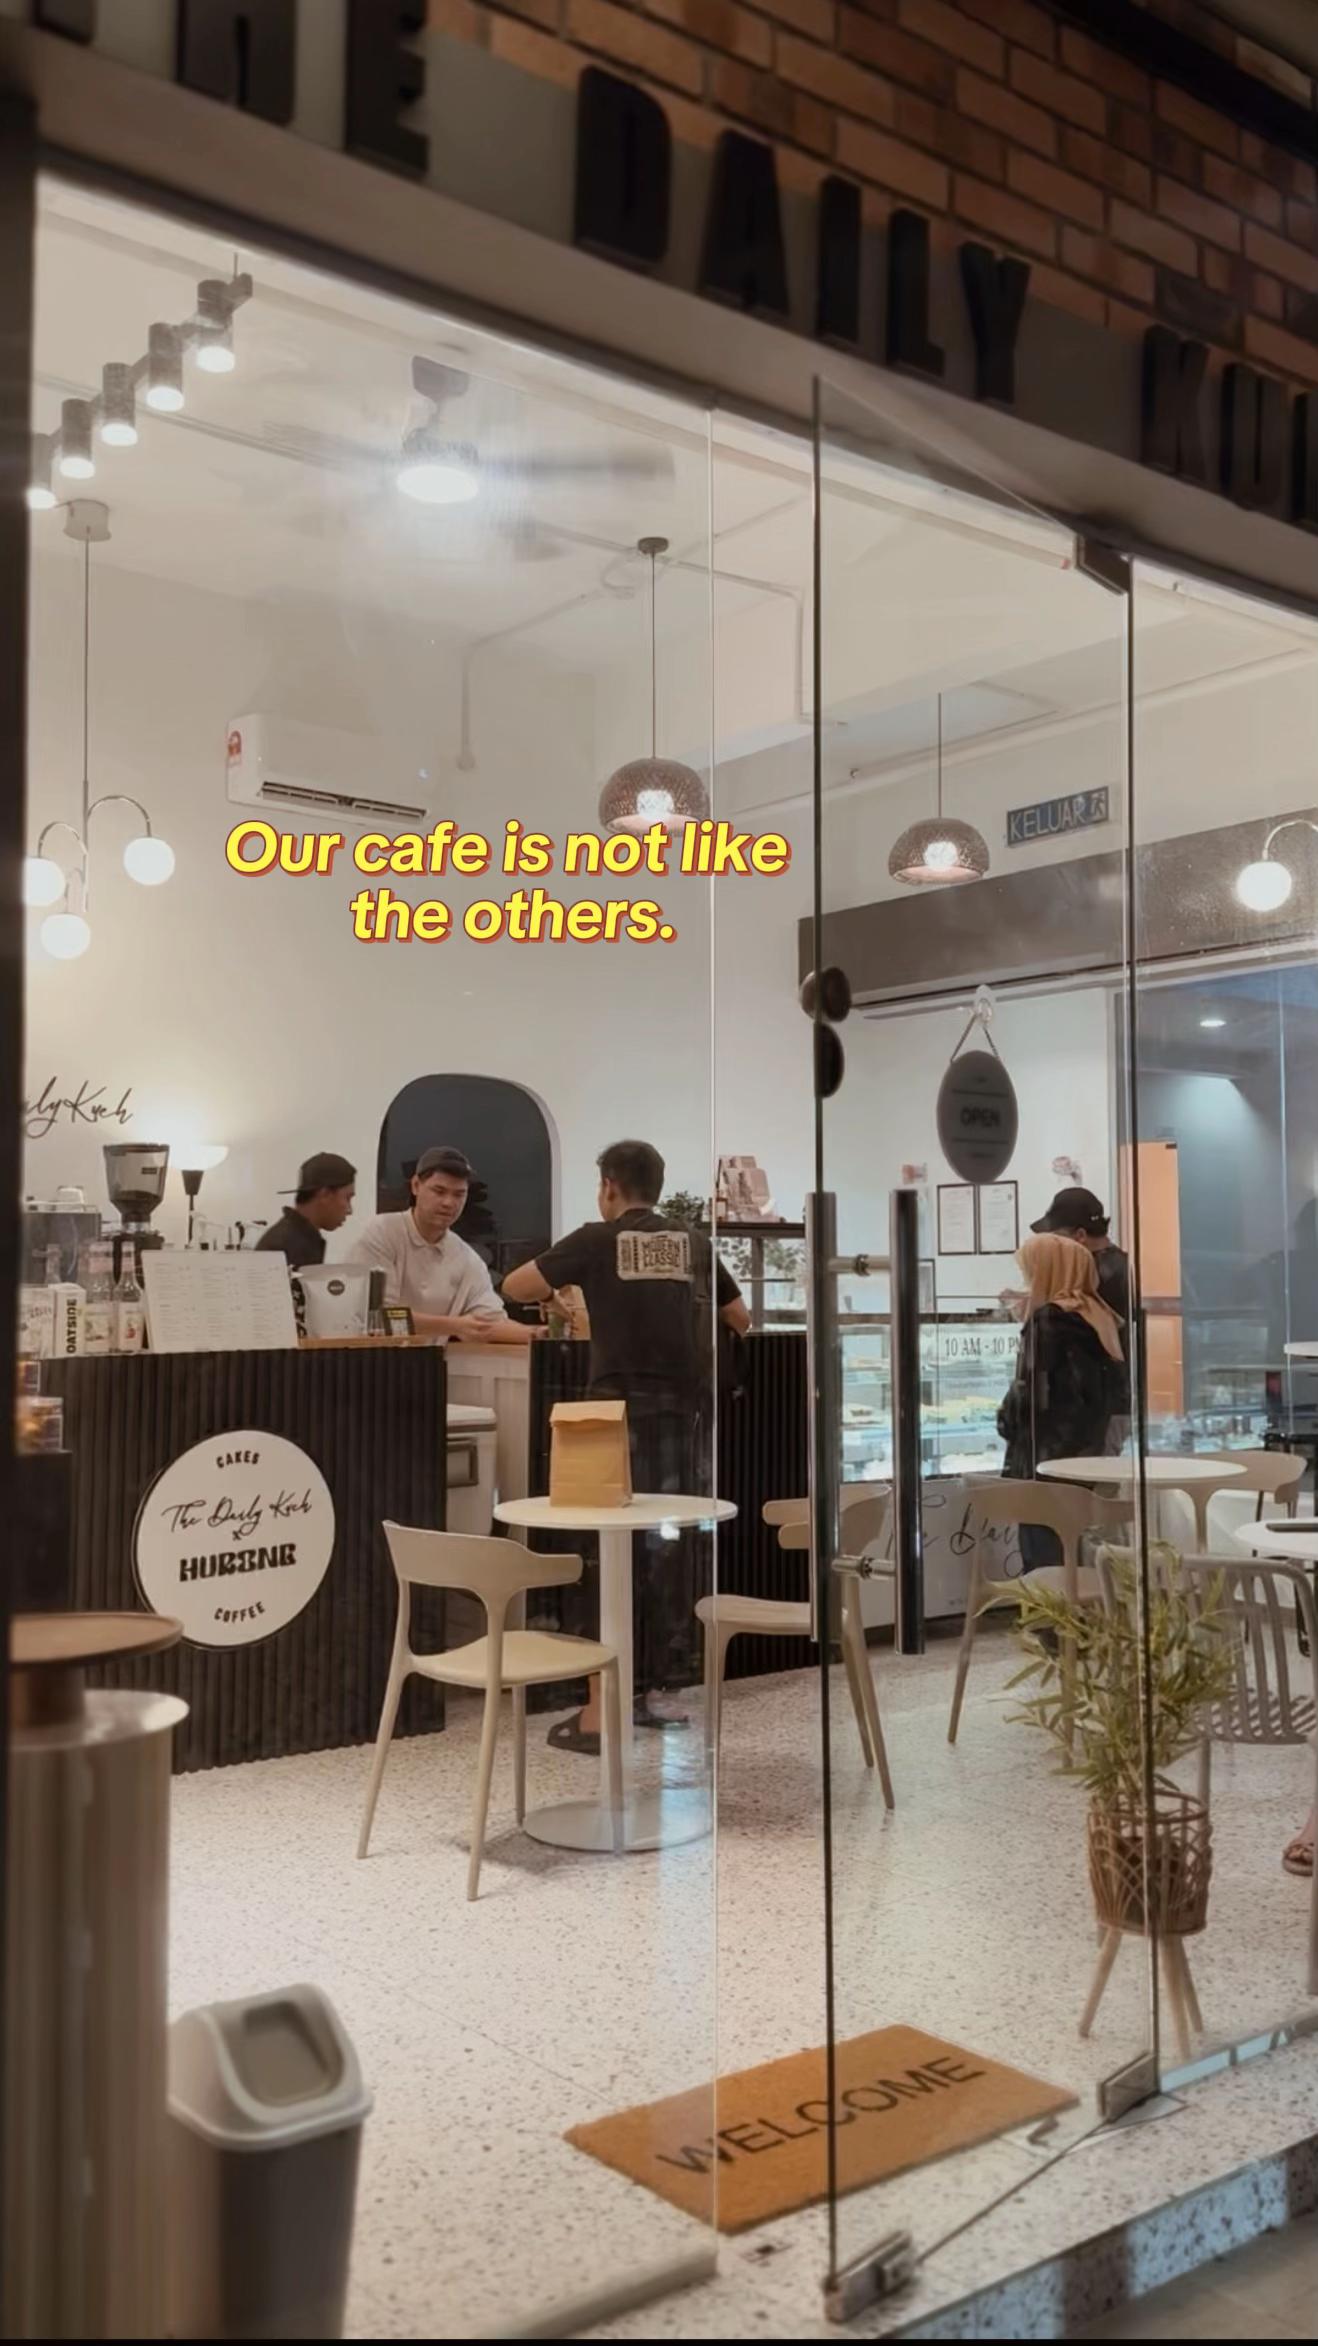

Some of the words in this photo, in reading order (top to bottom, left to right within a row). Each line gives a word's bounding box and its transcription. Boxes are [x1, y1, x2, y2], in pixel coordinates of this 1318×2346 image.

[574, 63, 1032, 404] DAILY
[1138, 322, 1318, 532] KU
[1009, 796, 1087, 842] KELUAR
[961, 1106, 1000, 1128] OPEN
[66, 1298, 78, 1354] OATSIDE
[945, 1337, 958, 1356] 10
[961, 1337, 981, 1356] AM
[993, 1336, 1005, 1355] 10
[216, 1450, 260, 1469] CAKES
[161, 1499, 207, 1533] The
[214, 1601, 265, 1624] COFFEE
[655, 2056, 987, 2174] WELCOME
